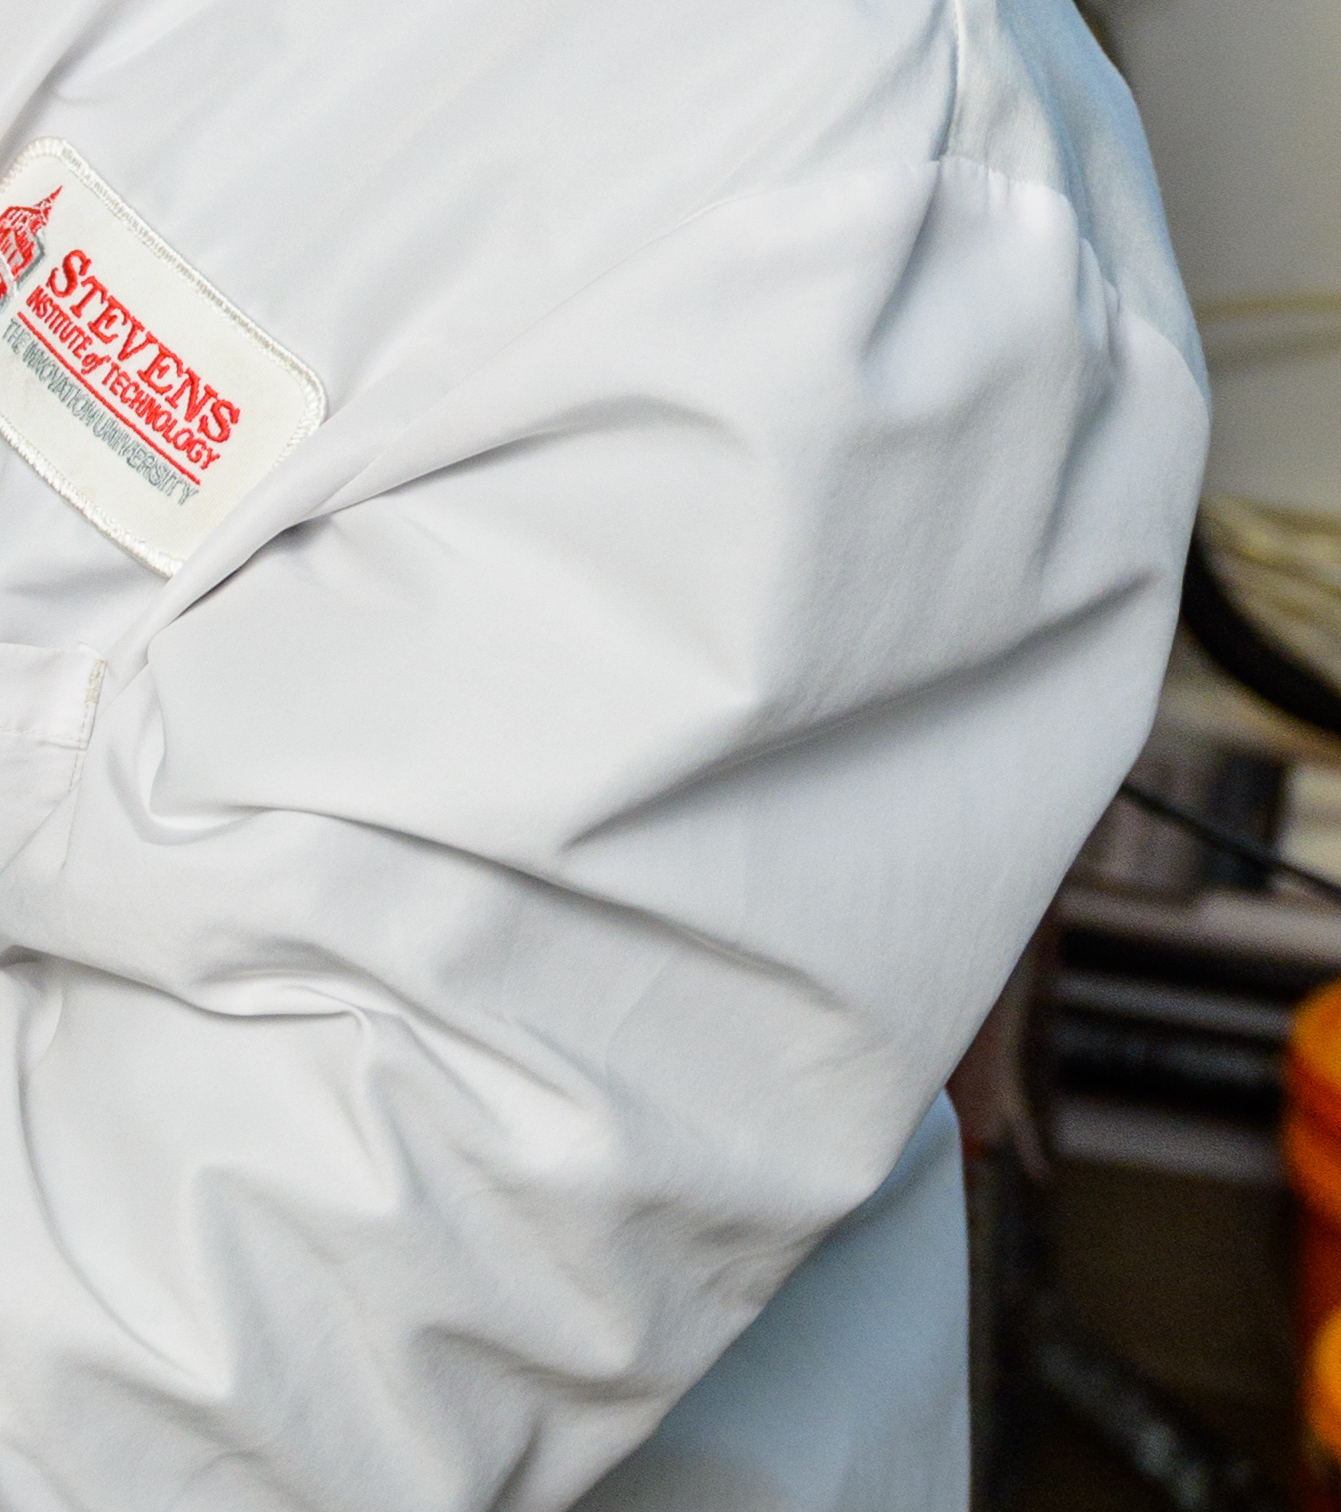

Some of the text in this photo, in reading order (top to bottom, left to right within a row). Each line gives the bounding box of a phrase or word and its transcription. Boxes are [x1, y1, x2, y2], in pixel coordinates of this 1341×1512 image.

[2, 317, 200, 507] THE INNOVATION UNIVERSITY
[25, 285, 221, 471] INSTITUTE of TECHNOLOGY
[46, 249, 241, 443] STEVENS
